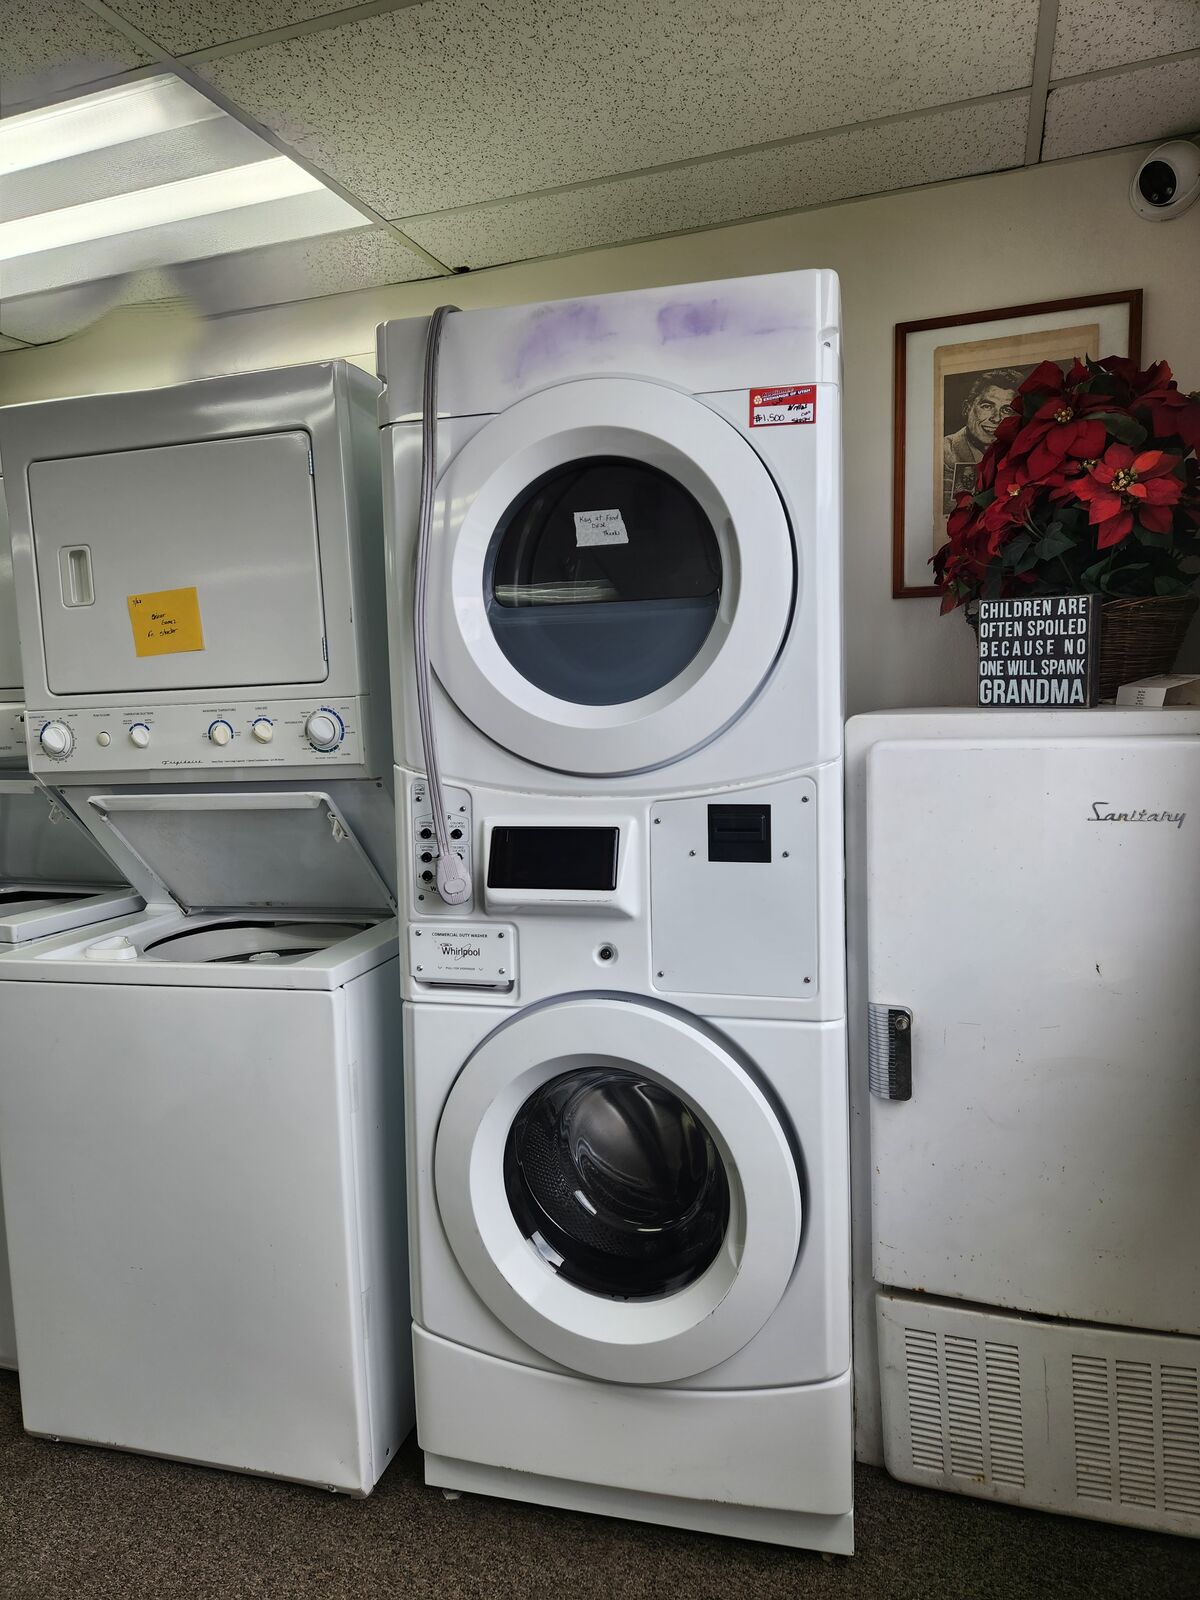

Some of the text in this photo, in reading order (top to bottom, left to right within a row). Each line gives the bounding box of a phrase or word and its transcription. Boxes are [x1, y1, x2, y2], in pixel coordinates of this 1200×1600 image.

[981, 597, 1087, 619] CHILDREN ARE
[980, 618, 1087, 638] OFTEN SPOILED
[980, 638, 1086, 657] BECAUSE NO
[980, 659, 1085, 676] ONE WILL SPANK
[980, 678, 1085, 704] GRANDMA
[1087, 802, 1187, 829] Sanitary
[441, 946, 481, 957] Whirlpool
